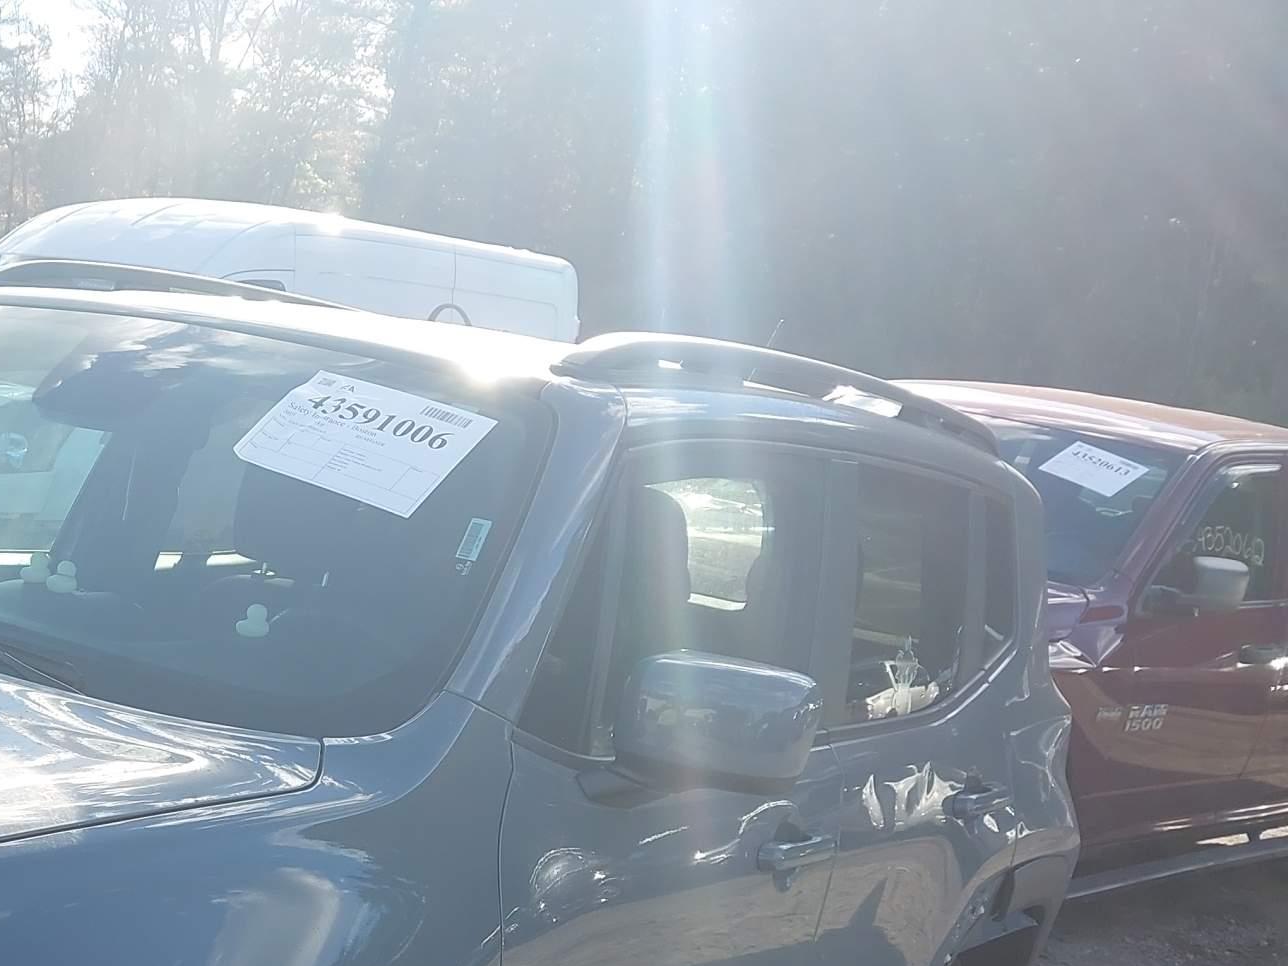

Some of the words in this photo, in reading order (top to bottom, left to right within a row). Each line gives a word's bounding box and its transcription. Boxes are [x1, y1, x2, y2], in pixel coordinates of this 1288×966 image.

[309, 395, 454, 449] 43591006
[1128, 704, 1168, 718] RAM
[1124, 718, 1164, 732] 1500
